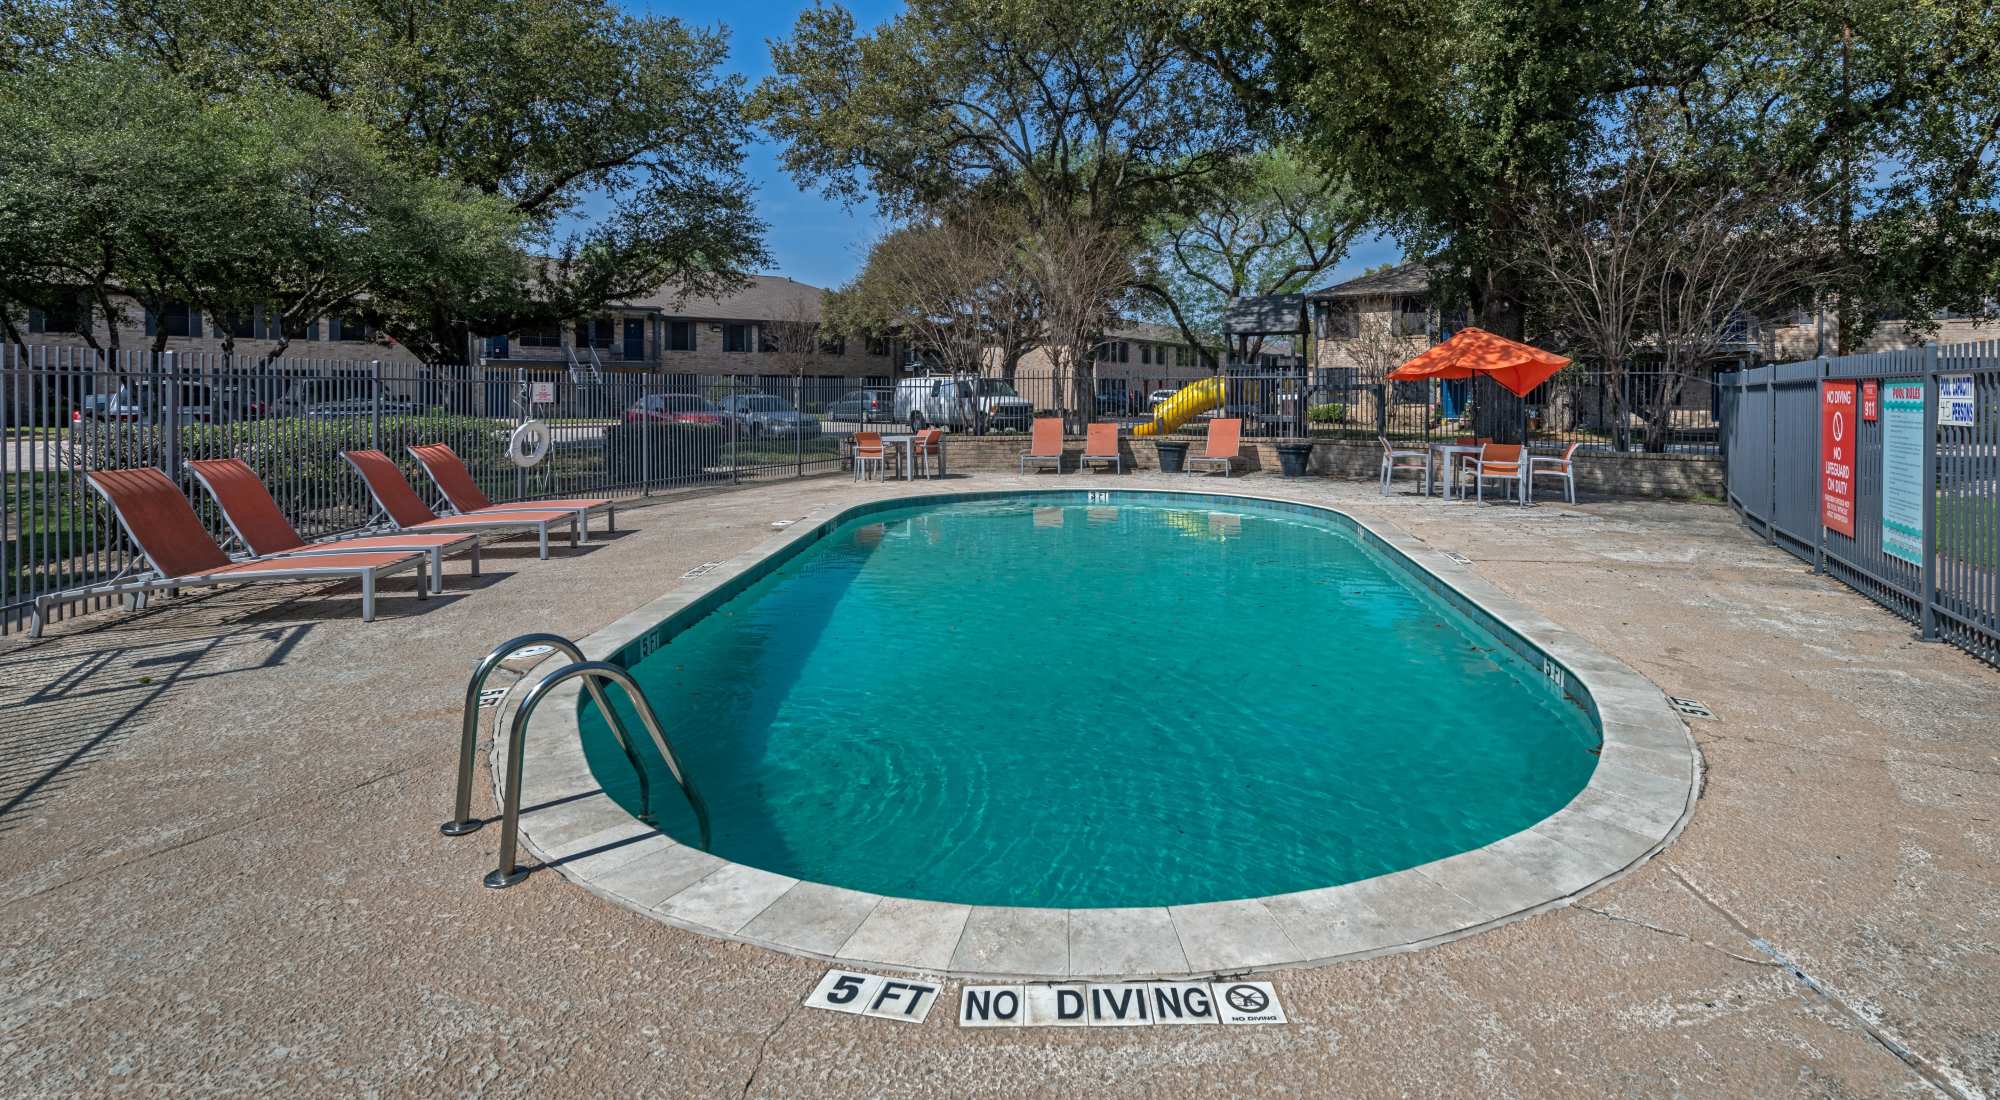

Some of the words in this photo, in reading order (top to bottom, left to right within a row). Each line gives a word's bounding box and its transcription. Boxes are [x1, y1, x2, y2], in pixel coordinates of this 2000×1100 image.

[1905, 387, 1921, 399] RULES
[1941, 377, 1951, 396] POOL
[1953, 376, 1973, 396] CAPACITY
[1826, 390, 1834, 404] NO
[1835, 390, 1852, 405] DIVING
[1864, 401, 1875, 417] 911
[1940, 400, 1951, 418] 45
[1952, 402, 1973, 422] PERSONS
[1833, 446, 1842, 460] NO
[1825, 461, 1850, 480] LIFEGUARD
[1827, 478, 1835, 492] ON
[1836, 481, 1848, 495] DUTY
[827, 975, 866, 1005] 5
[871, 981, 935, 1015] FT
[965, 990, 1019, 1021] NO
[1057, 987, 1212, 1020] DIVING
